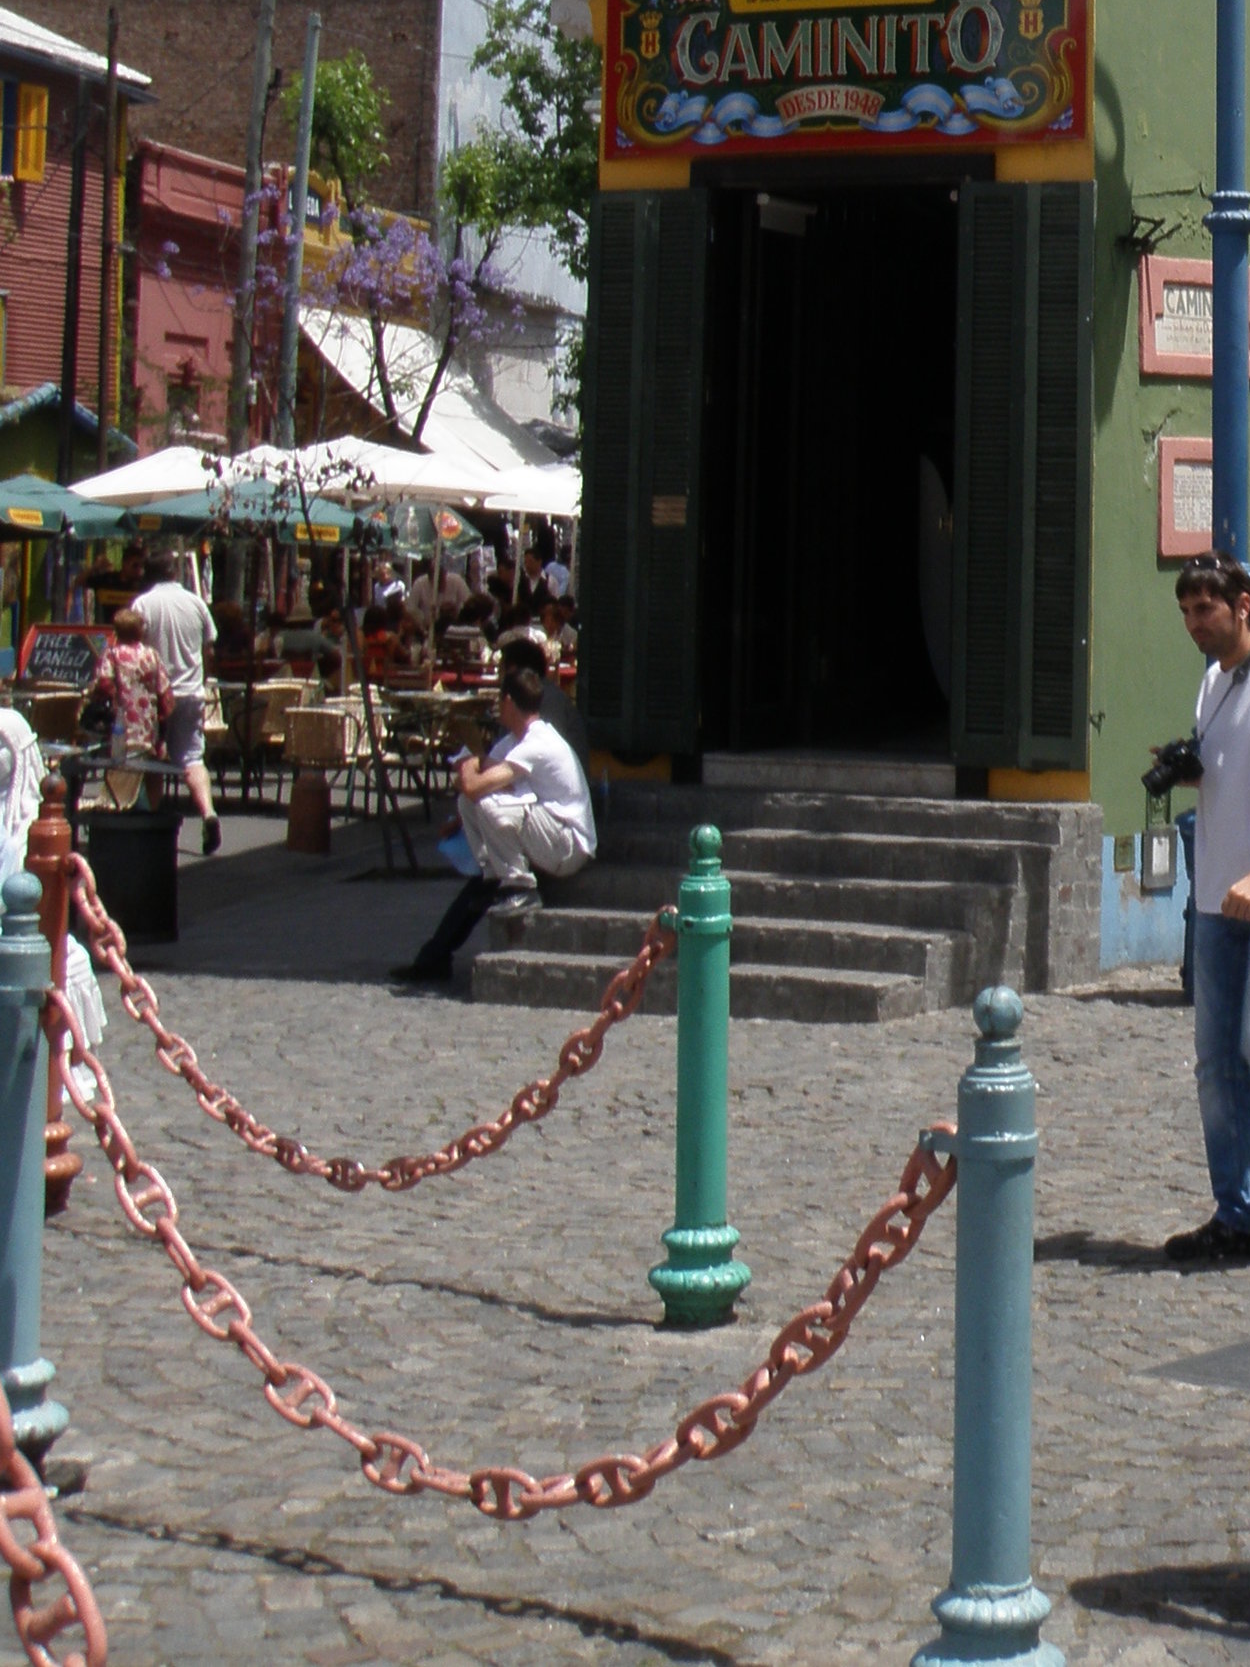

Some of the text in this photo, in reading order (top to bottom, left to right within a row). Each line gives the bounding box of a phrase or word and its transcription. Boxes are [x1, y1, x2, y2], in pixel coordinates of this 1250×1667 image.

[782, 88, 881, 121] DESDE 1948
[1165, 287, 1213, 318] CAMIN
[35, 633, 73, 649] FREE
[33, 649, 91, 668] TANGO
